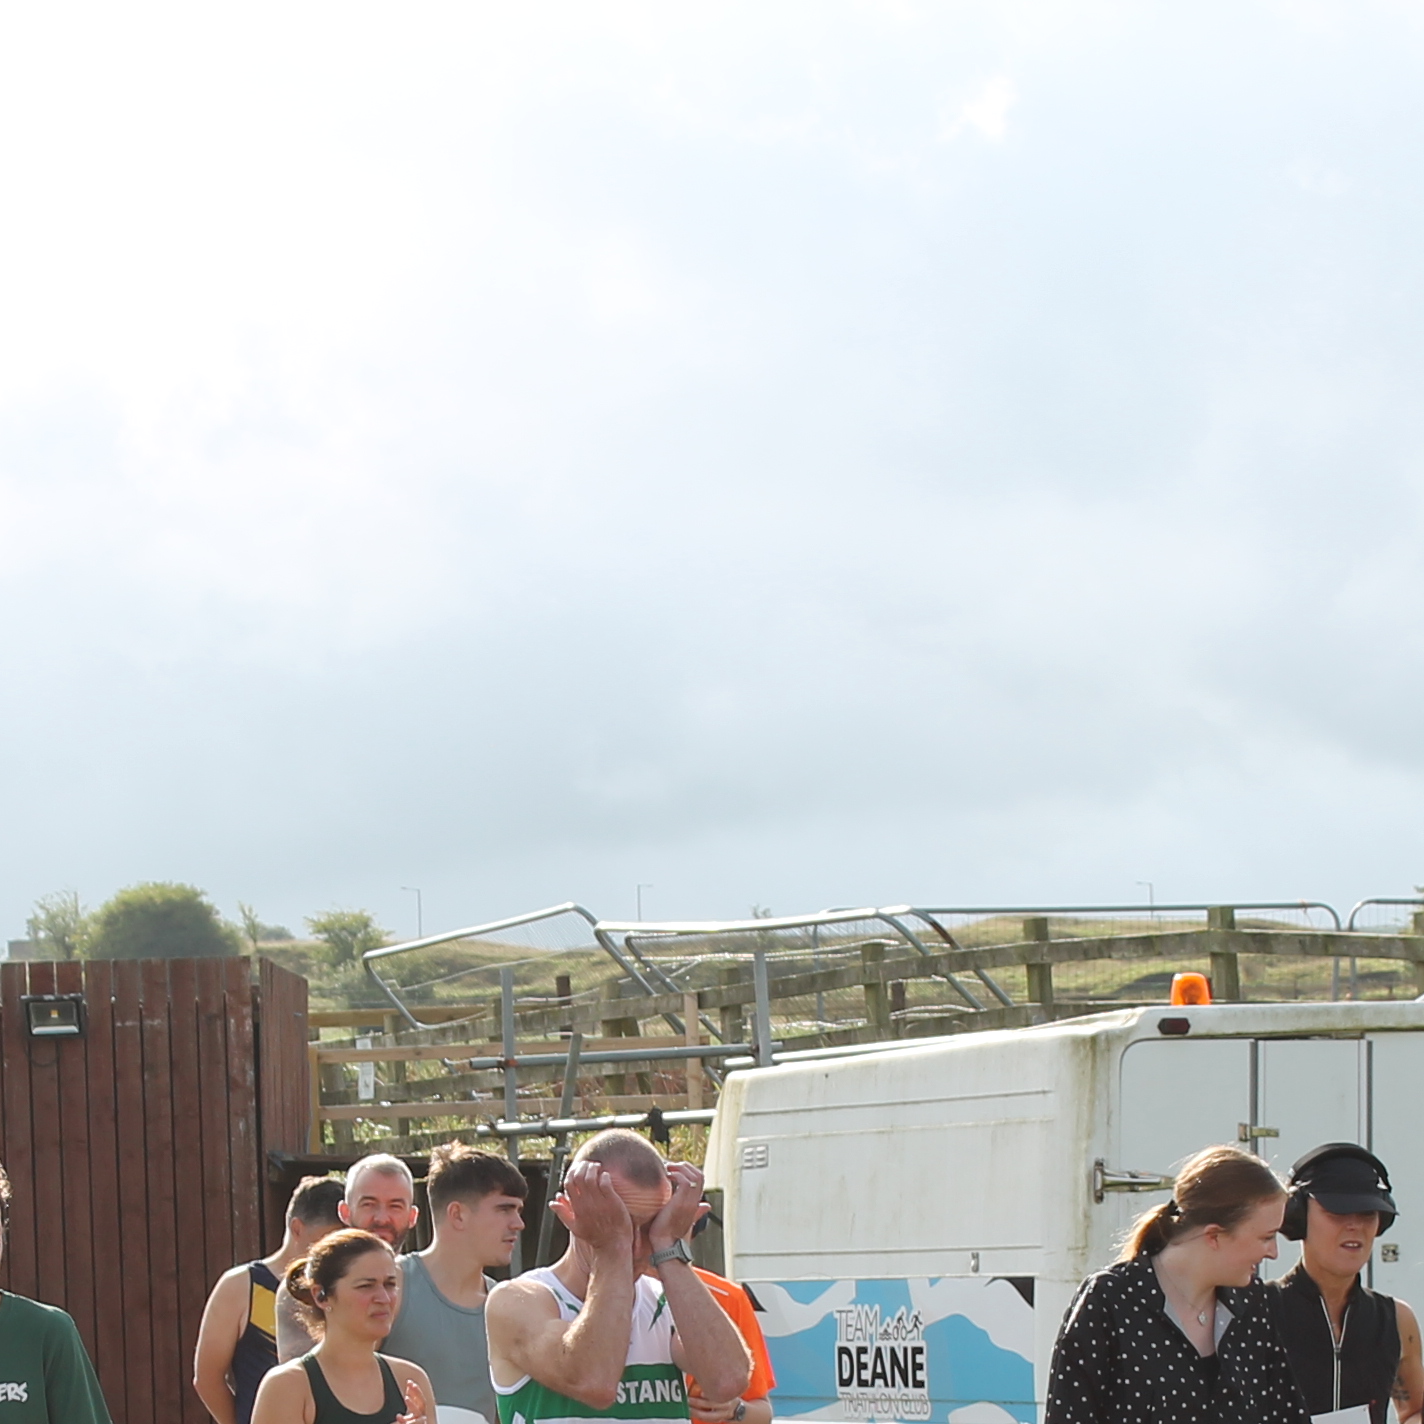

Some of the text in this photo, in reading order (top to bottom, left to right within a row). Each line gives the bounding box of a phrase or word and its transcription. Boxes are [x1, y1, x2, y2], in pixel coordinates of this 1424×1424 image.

[835, 1309, 878, 1342] TEAM
[837, 1345, 925, 1389] DEANE
[839, 1391, 929, 1415] TRIATHLON CLUB
